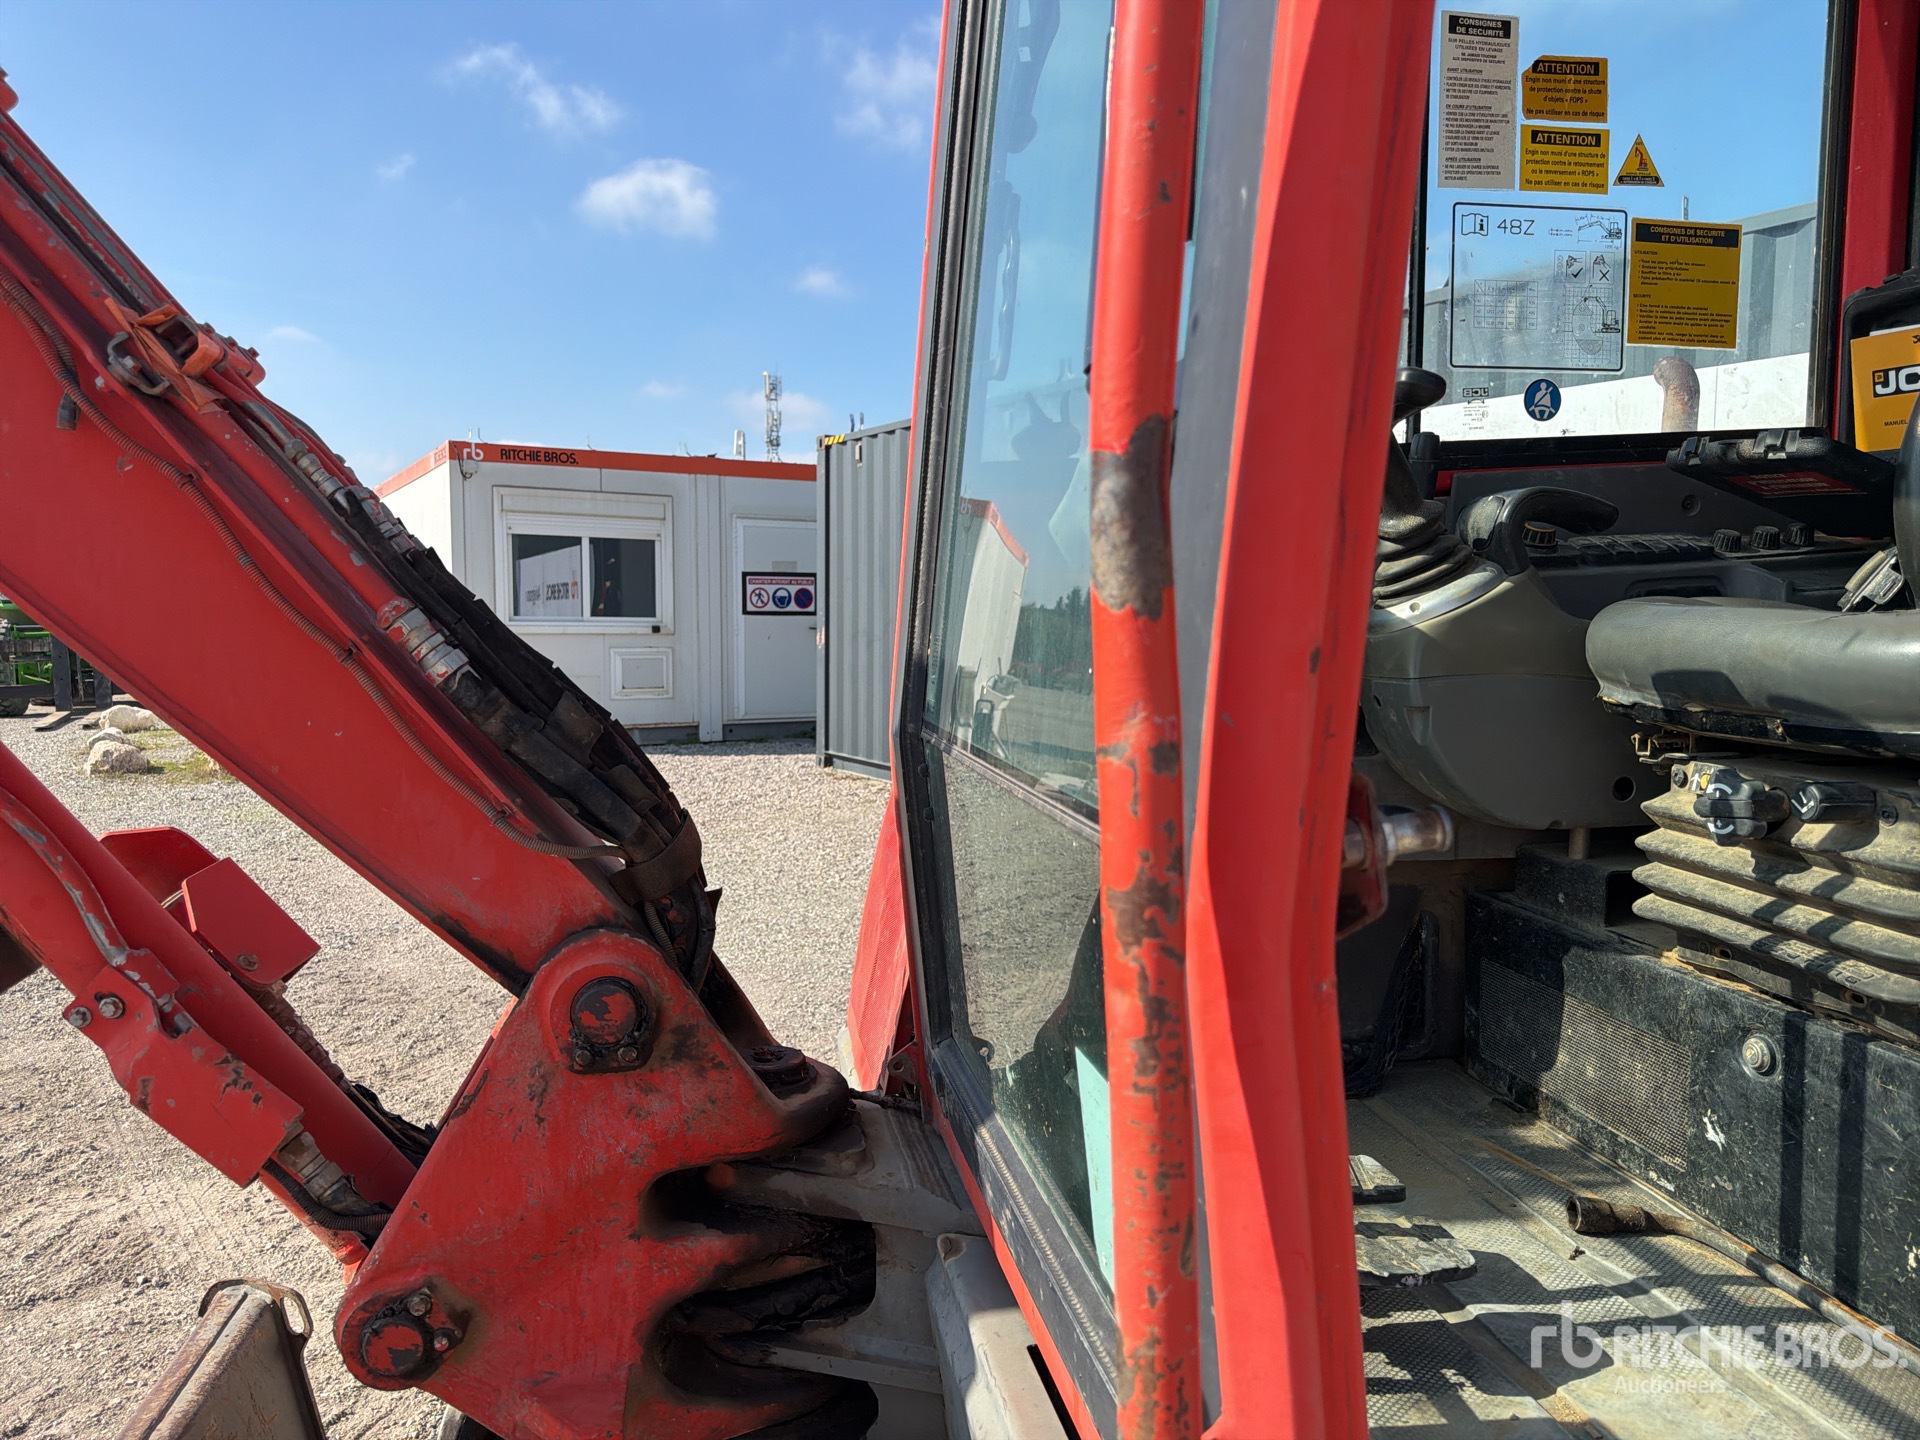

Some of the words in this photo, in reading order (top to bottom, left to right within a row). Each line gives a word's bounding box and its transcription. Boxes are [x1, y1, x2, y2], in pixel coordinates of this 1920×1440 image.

[1459, 18, 1502, 27] CONSIGNES
[1468, 28, 1504, 37] SECURITE
[1537, 63, 1594, 74] ATTENTION
[1536, 133, 1596, 145] ATTENTION
[1525, 148, 1539, 156] Engin
[1497, 219, 1535, 236] 48Z
[1650, 226, 1685, 234] CONSIGNES
[1671, 236, 1713, 244] D'UTILISATION
[501, 448, 541, 462] RITCHIE
[544, 450, 578, 464] BROS.
